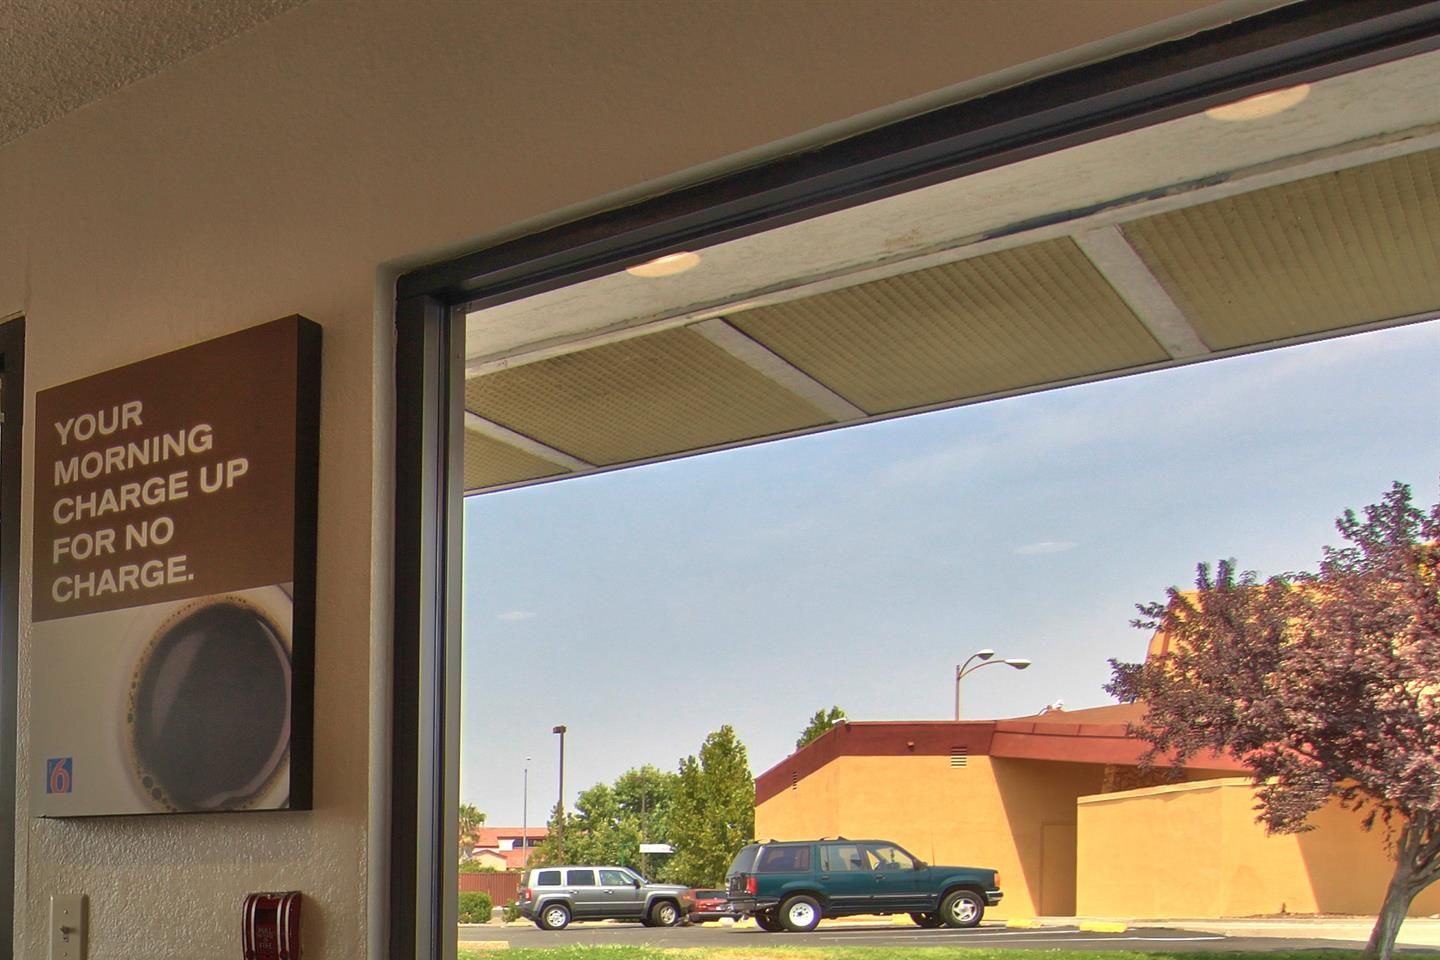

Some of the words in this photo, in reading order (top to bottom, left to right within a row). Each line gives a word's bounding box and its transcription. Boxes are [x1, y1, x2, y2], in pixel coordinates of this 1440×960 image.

[54, 400, 143, 446] YOUR
[54, 424, 214, 486] MORNING
[52, 471, 189, 524] CHARGE
[200, 458, 248, 494] UP
[52, 527, 115, 564] FOR
[125, 517, 174, 551] NO
[51, 555, 194, 602] CHARGE.
[50, 759, 69, 793] 6
